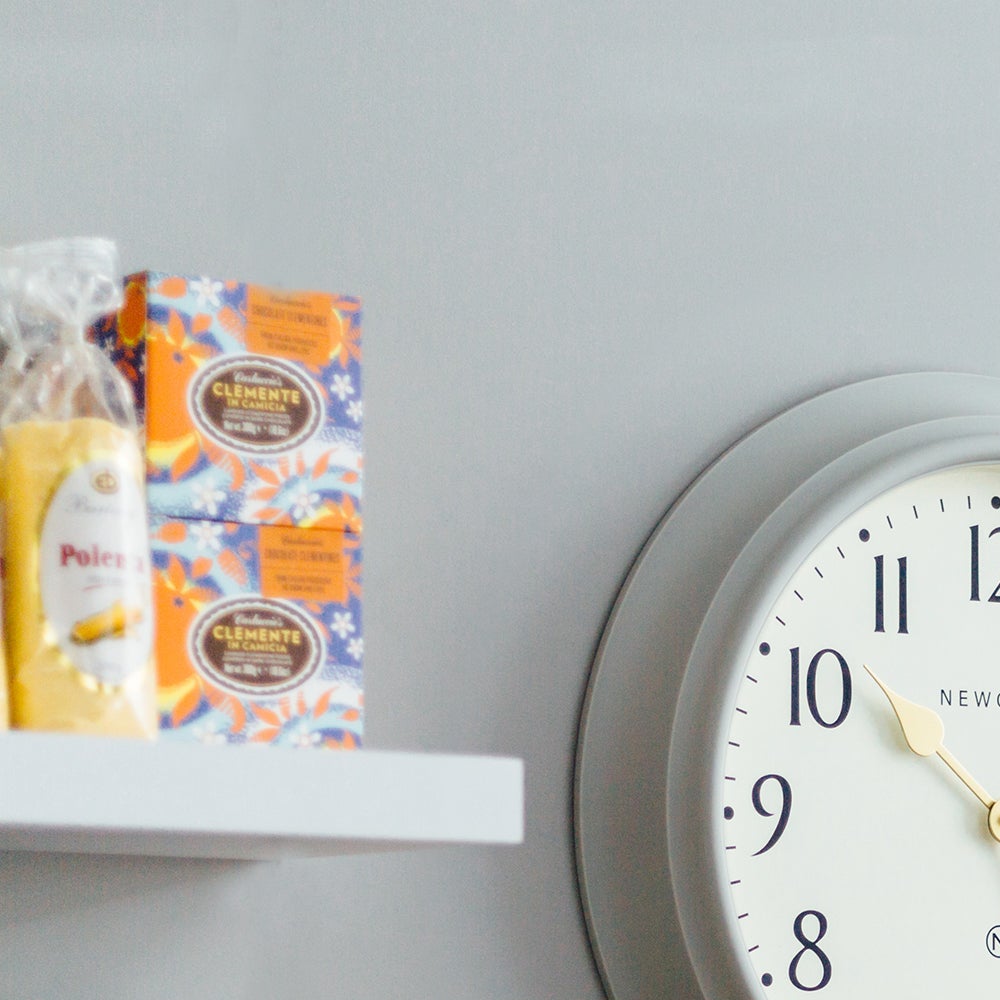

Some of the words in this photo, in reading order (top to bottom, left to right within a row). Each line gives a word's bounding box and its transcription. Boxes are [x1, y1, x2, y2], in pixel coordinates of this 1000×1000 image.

[212, 382, 301, 404] CLEMENTE
[874, 555, 909, 633] 11
[212, 625, 302, 645] CLEMENTE
[789, 646, 852, 728] 10
[751, 774, 792, 857] 9
[788, 909, 834, 992] 8
